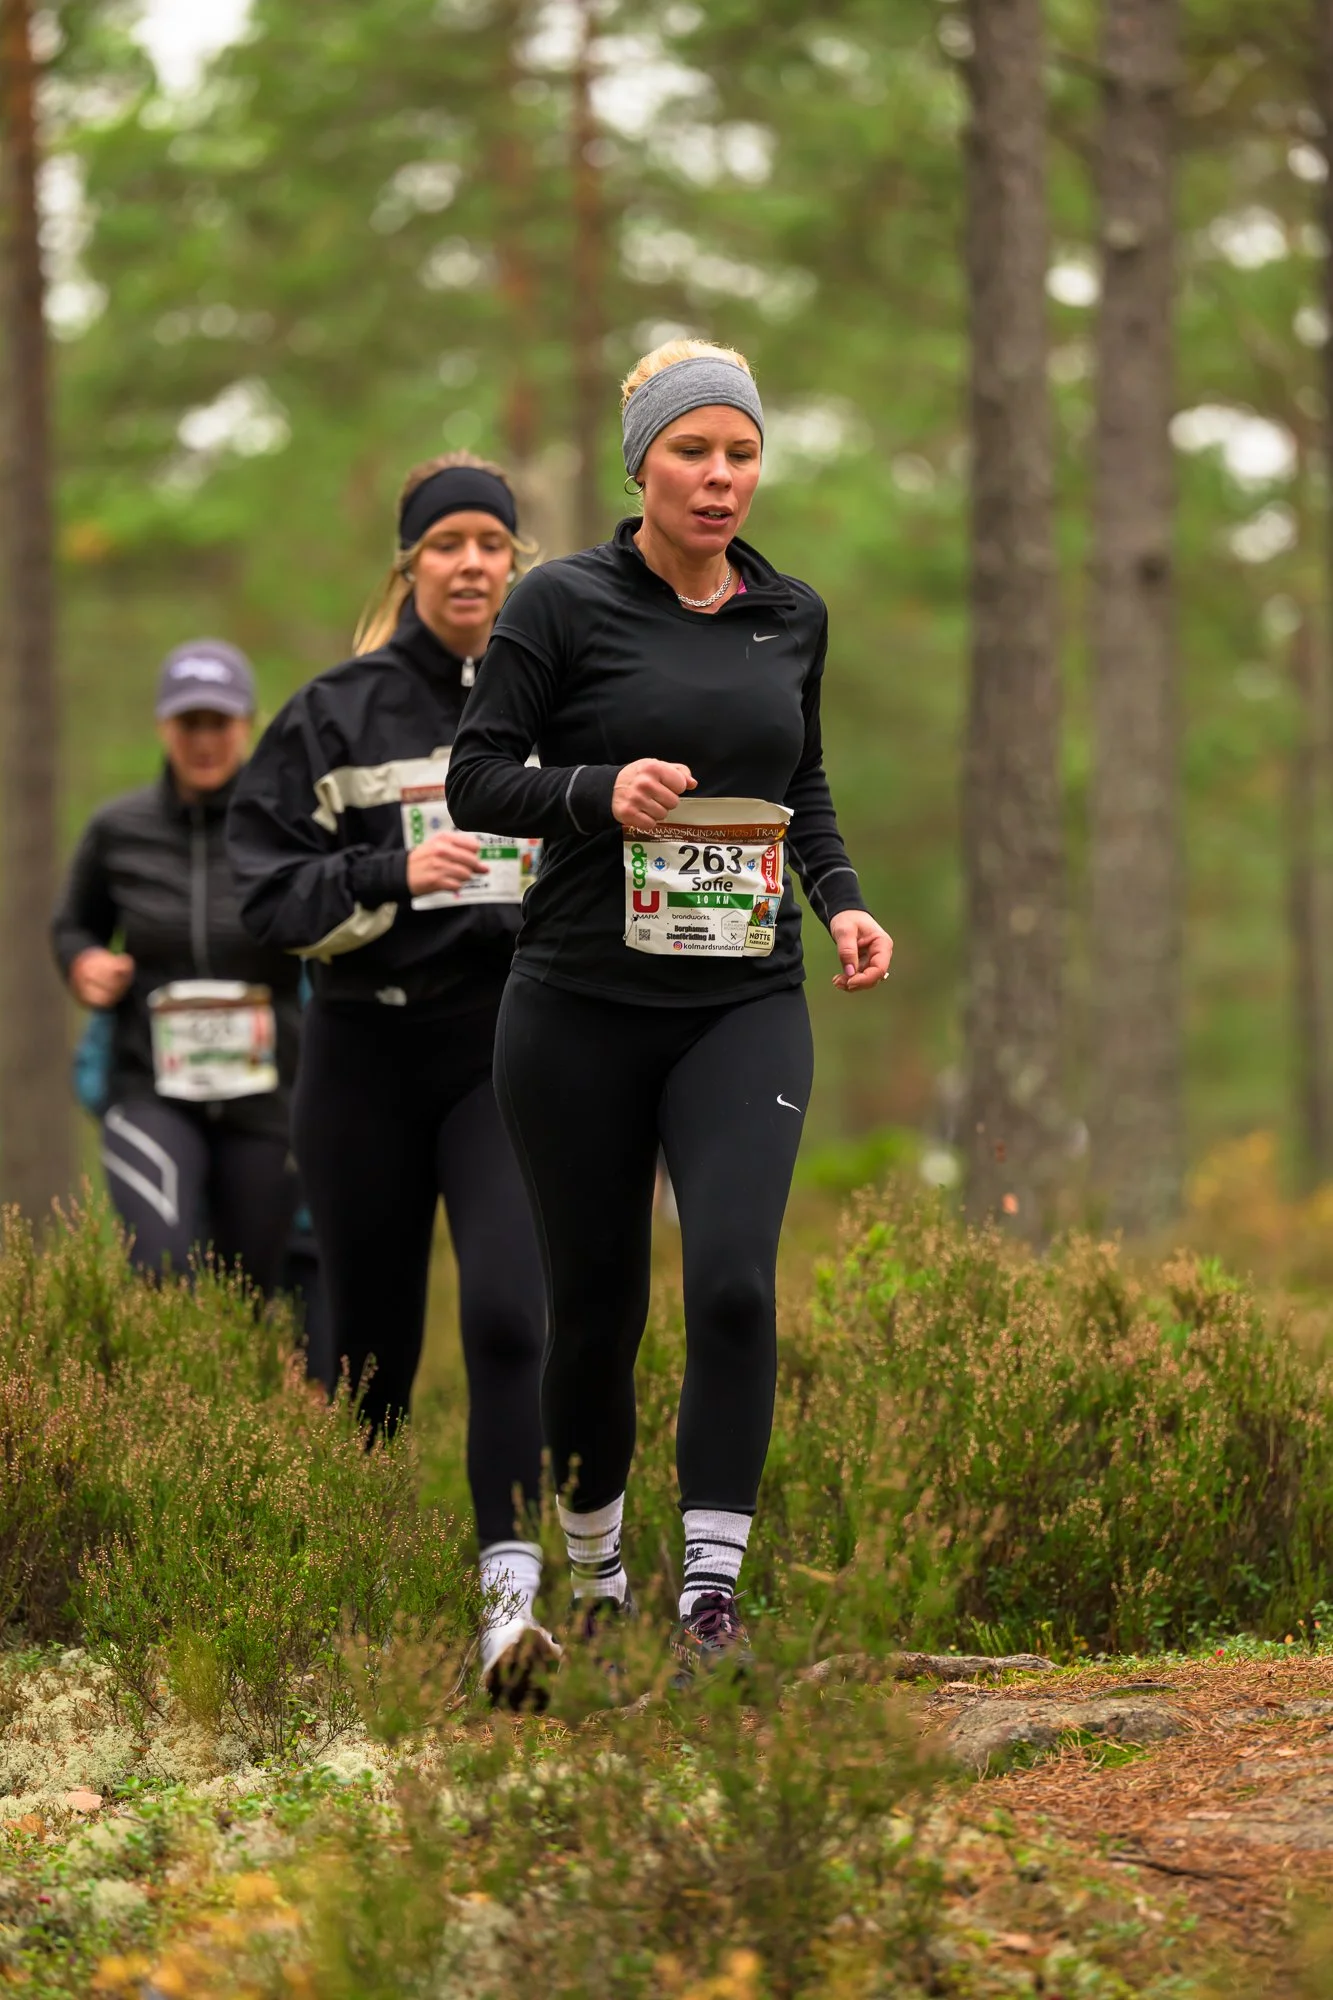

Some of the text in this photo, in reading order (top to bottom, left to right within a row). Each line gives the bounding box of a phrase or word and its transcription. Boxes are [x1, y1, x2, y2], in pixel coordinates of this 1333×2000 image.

[631, 843, 647, 889] coop
[678, 845, 743, 875] 263
[692, 877, 733, 892] Sofie
[696, 895, 729, 905] 10 KM
